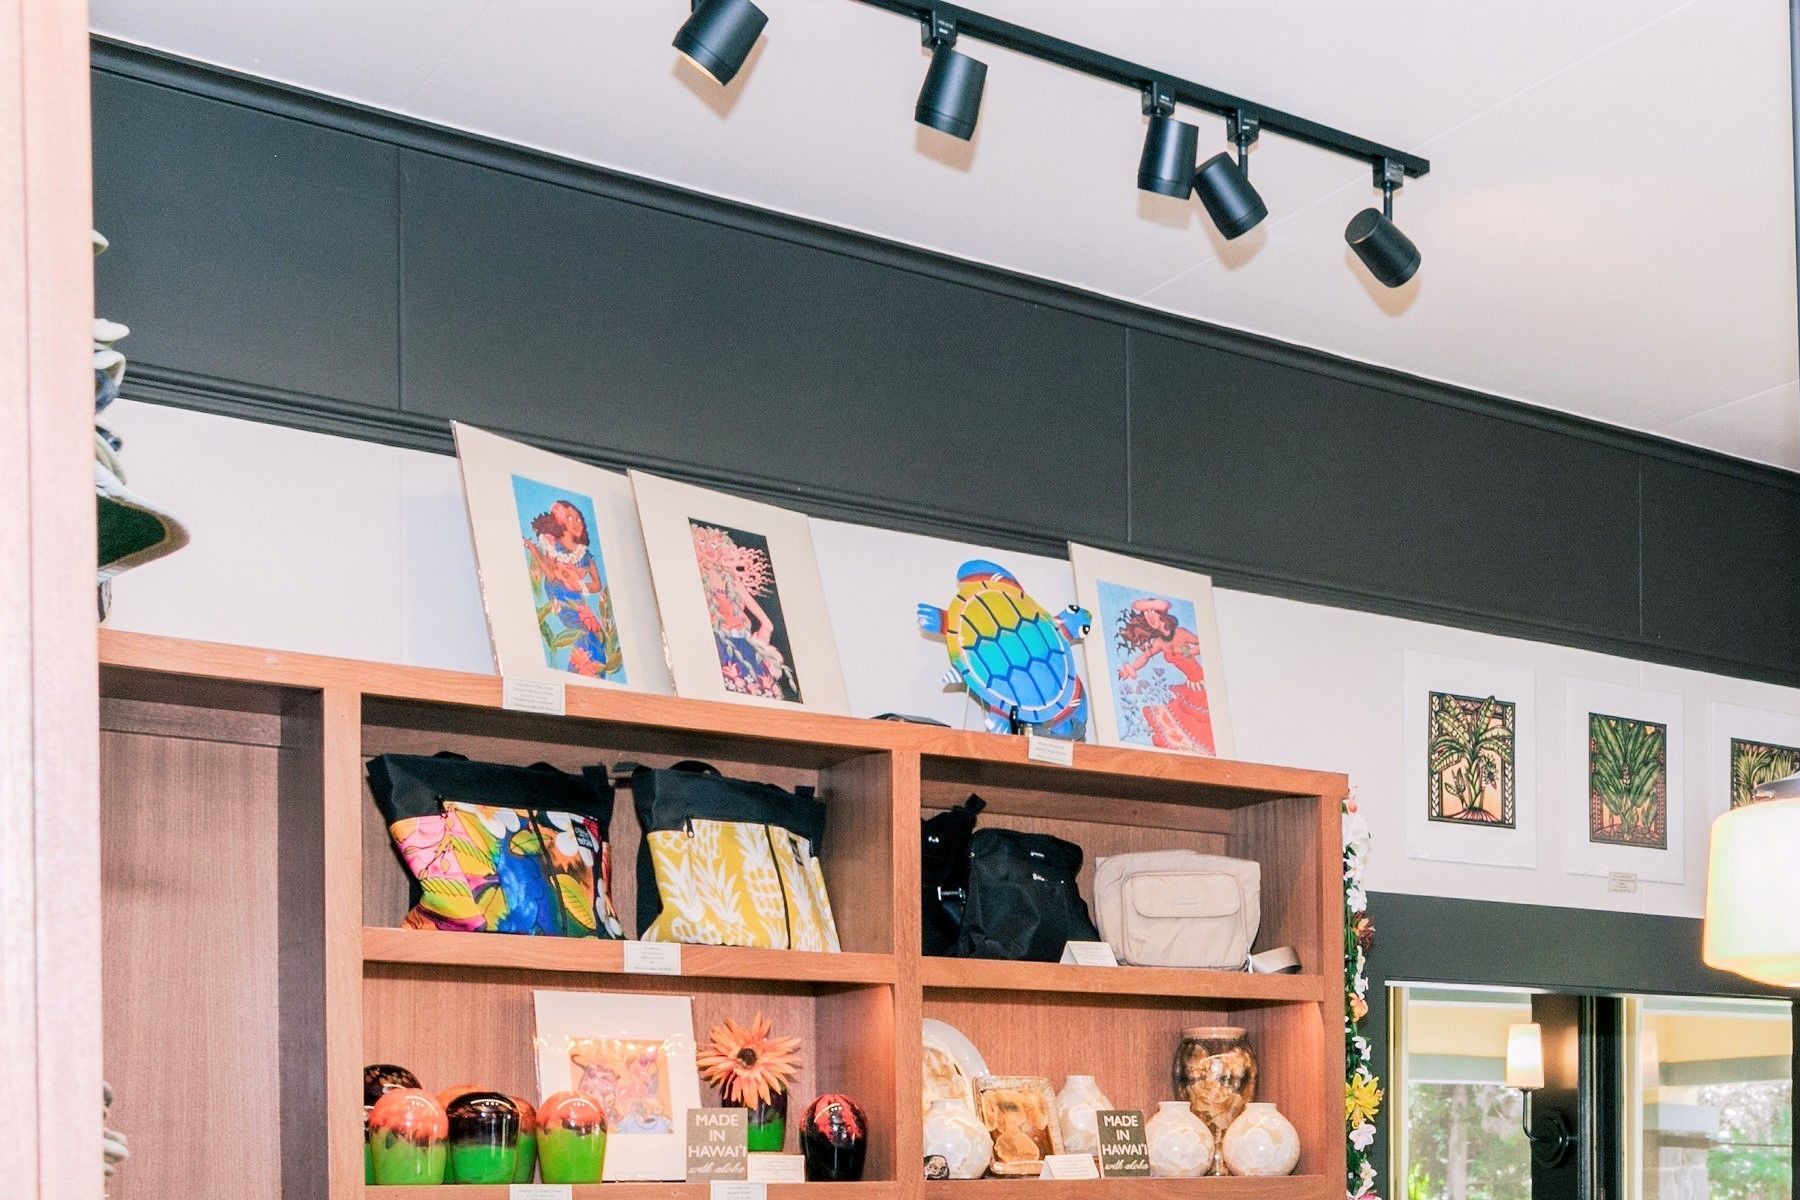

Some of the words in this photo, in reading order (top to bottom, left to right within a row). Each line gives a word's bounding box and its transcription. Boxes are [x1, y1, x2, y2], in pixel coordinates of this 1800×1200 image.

[695, 1114, 739, 1127] MADE
[1103, 1115, 1138, 1127] MADE
[709, 1129, 725, 1142] IN
[1116, 1129, 1130, 1141] IN
[688, 1162, 711, 1175] with
[714, 1162, 745, 1175] aloha
[1105, 1160, 1123, 1171] with
[1125, 1160, 1149, 1170] aloha
